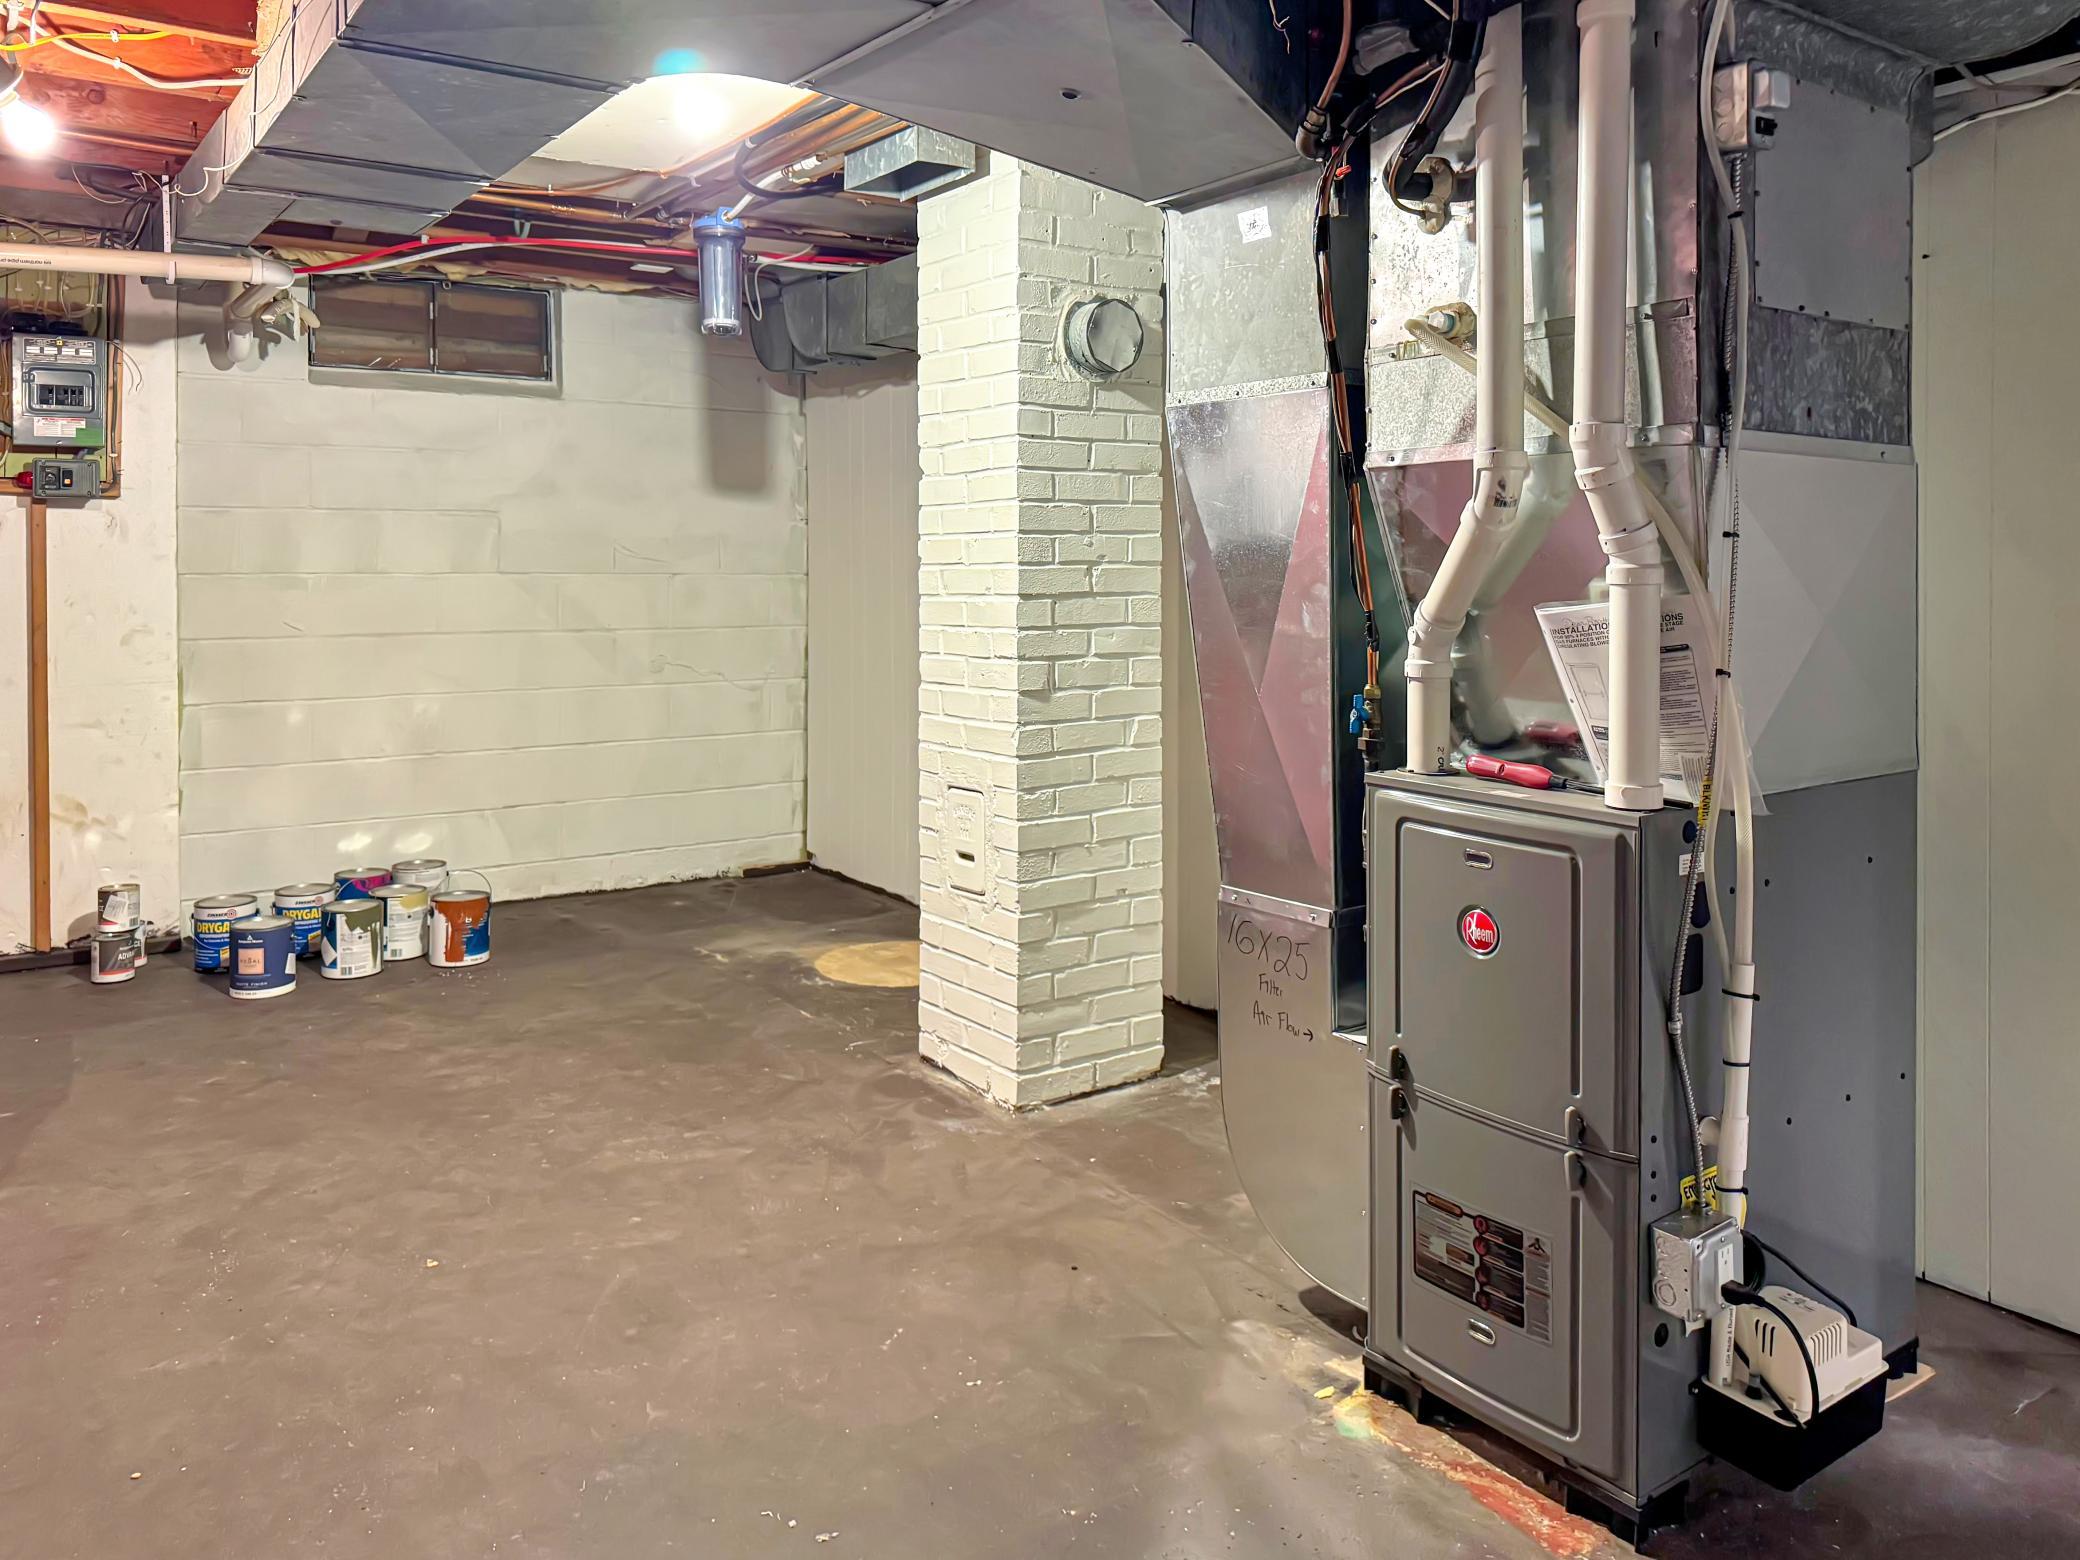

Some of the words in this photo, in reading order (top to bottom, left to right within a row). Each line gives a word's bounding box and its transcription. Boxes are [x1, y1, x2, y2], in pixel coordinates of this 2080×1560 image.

[1551, 622, 1609, 635] INSTALLATIO
[196, 922, 230, 934] DRYGA
[1466, 913, 1494, 945] Rheem
[1278, 1012, 1300, 1037] Flow
